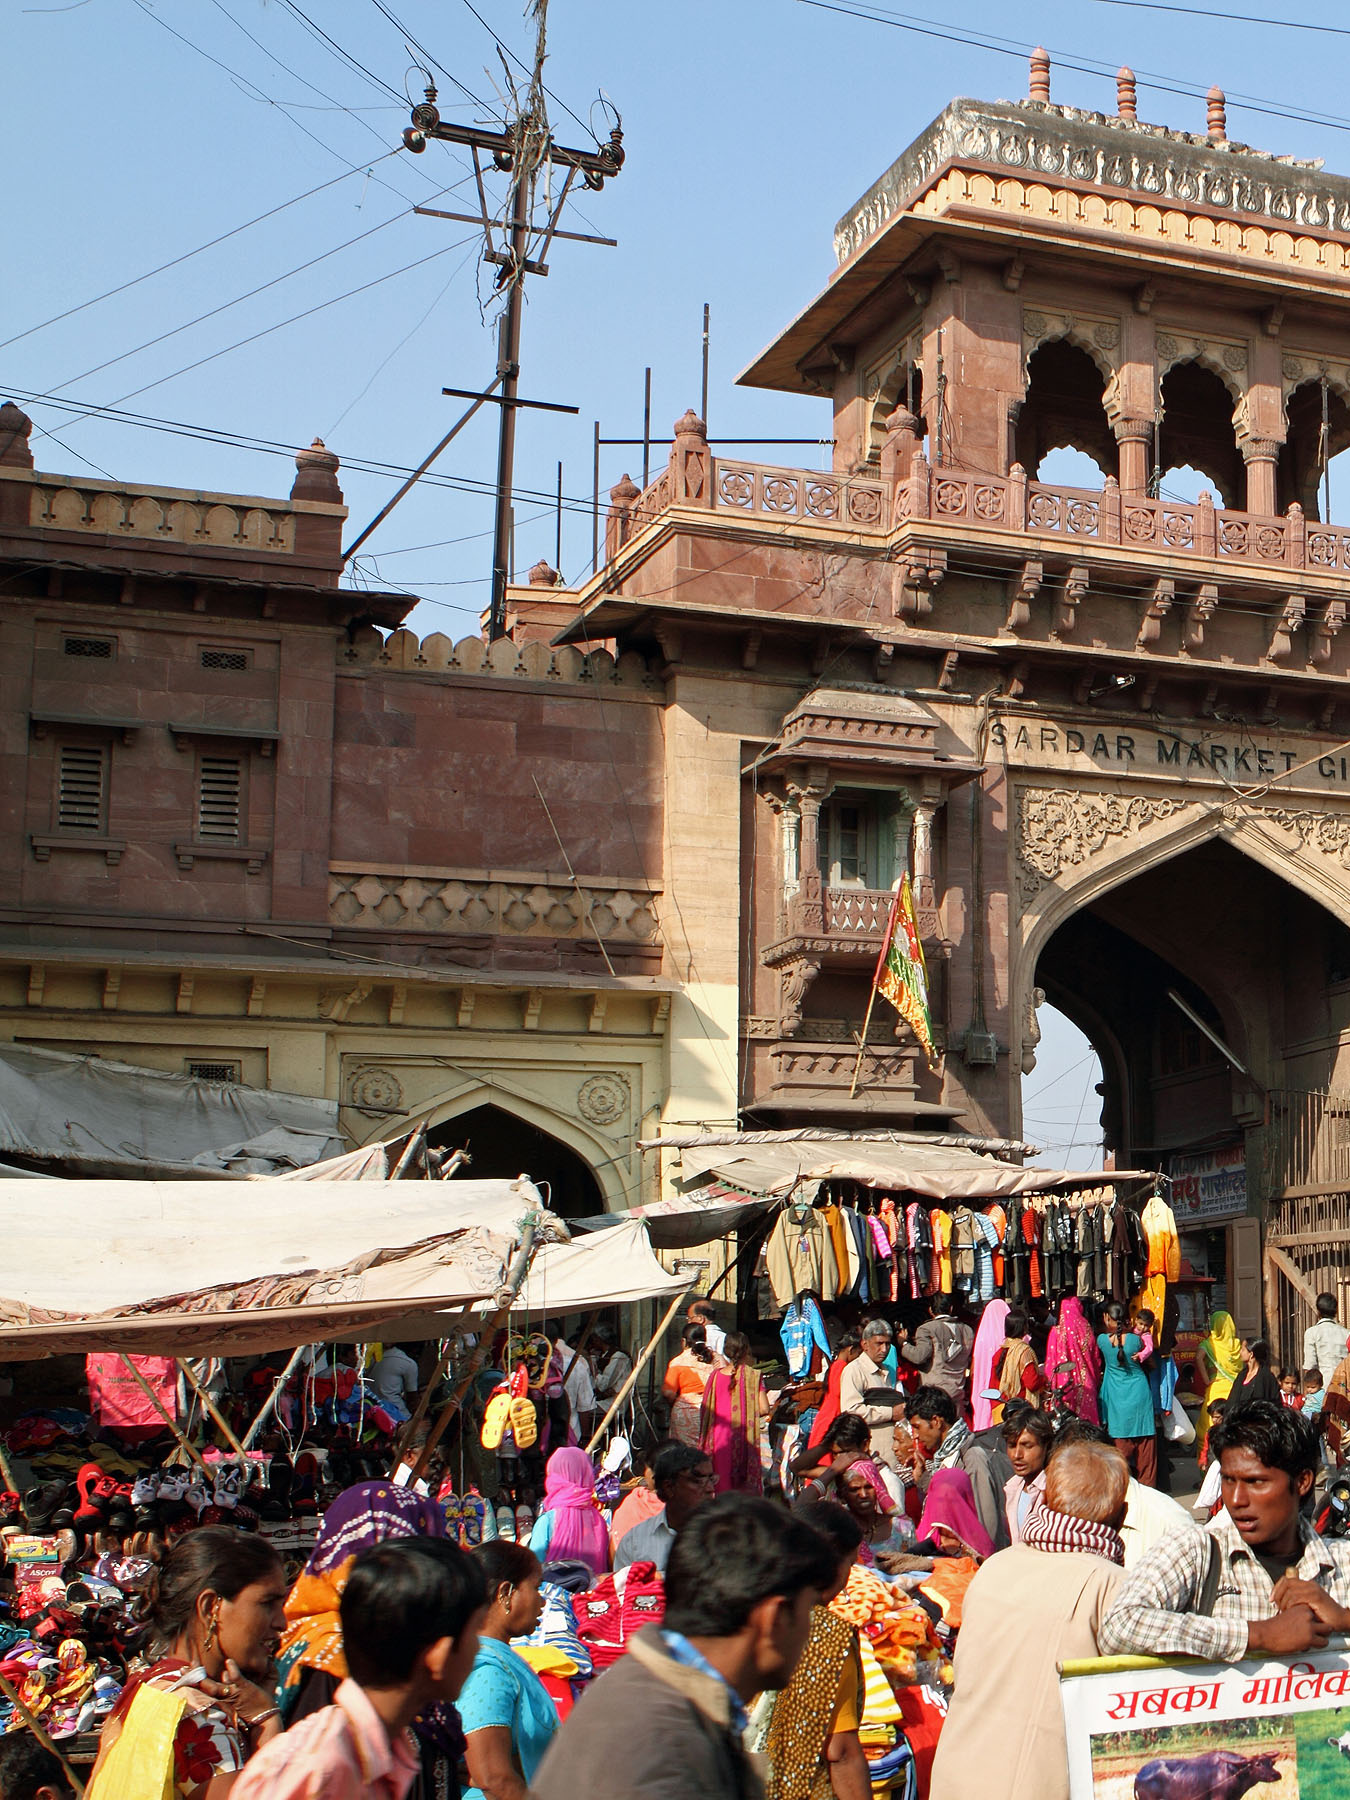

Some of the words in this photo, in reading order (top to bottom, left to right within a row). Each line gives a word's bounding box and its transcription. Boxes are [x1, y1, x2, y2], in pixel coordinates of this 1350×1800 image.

[991, 722, 1136, 761] SARDAR
[1157, 738, 1297, 775] MARKET
[29, 1569, 57, 1577] ASCOT
[1105, 1682, 1226, 1721] सबका
